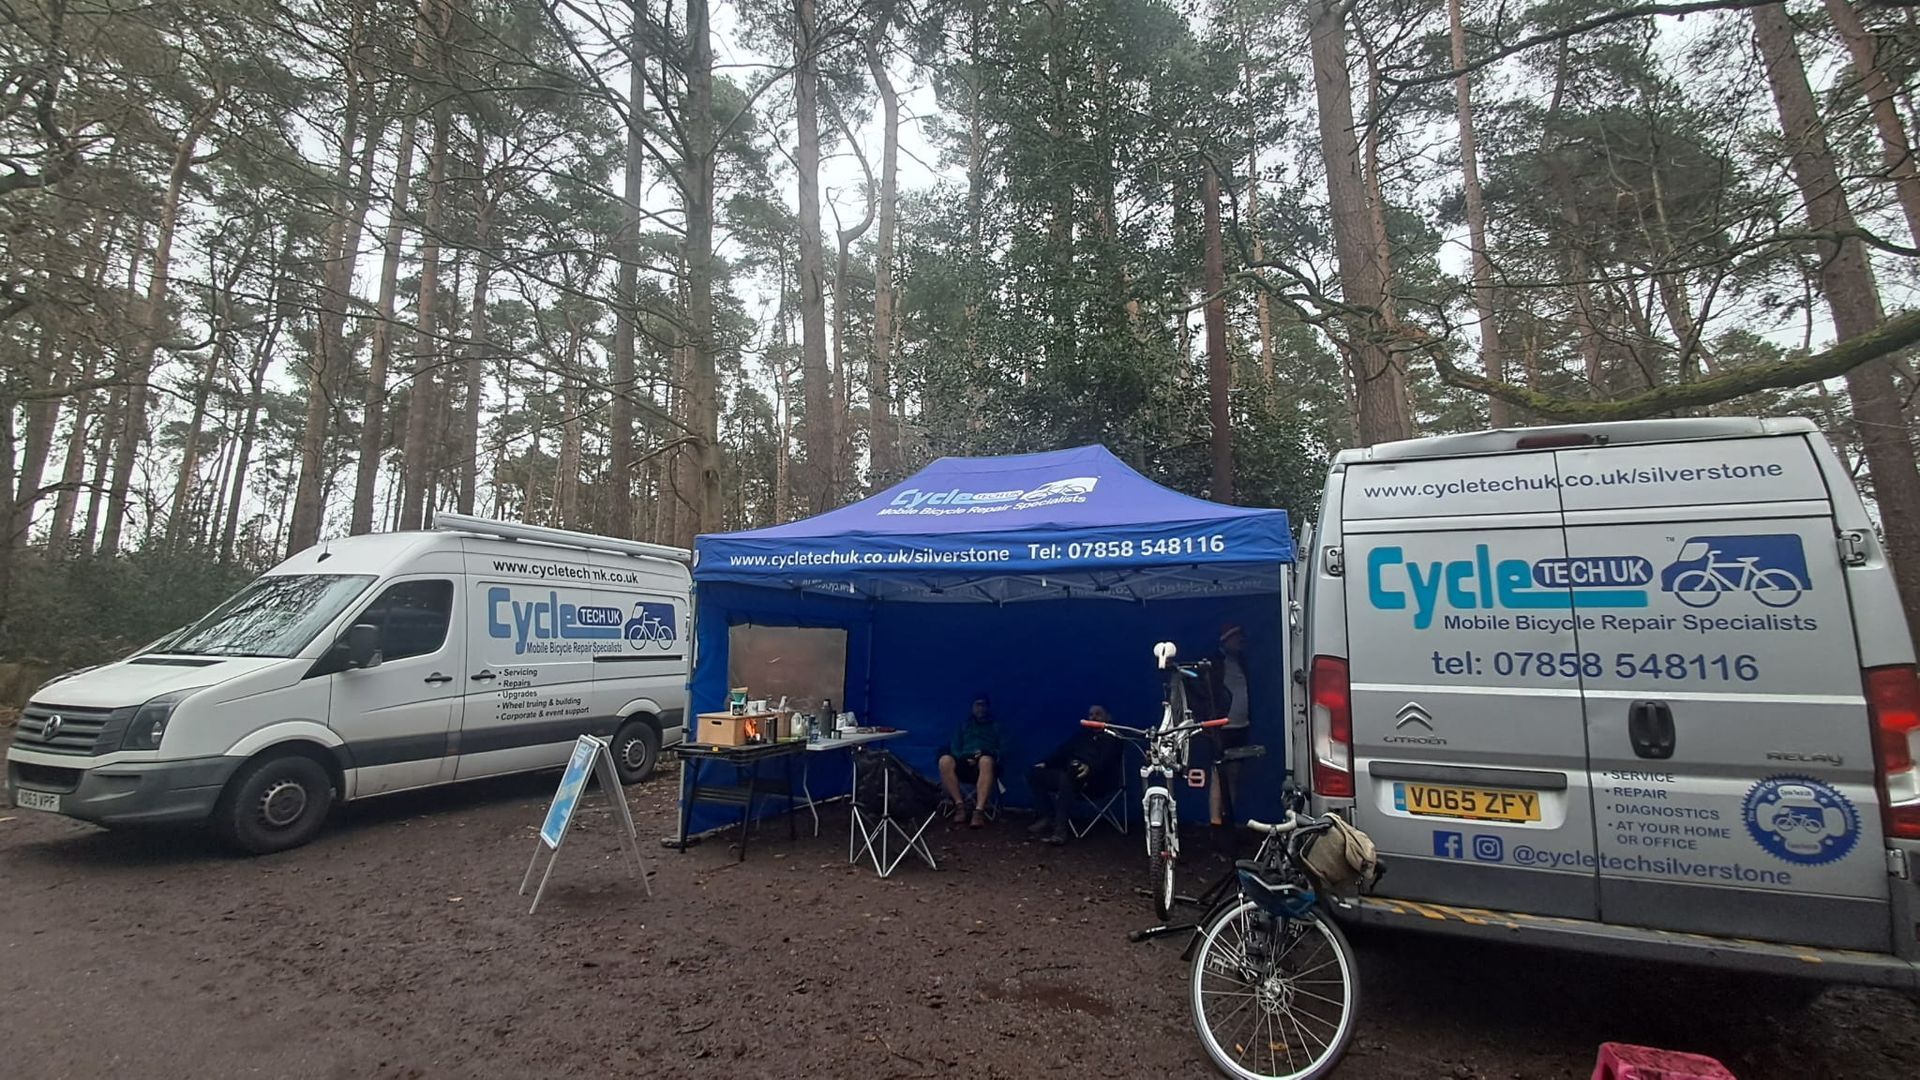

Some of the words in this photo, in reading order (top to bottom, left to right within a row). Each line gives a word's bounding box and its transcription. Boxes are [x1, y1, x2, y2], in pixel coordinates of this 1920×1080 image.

[1364, 461, 1782, 499] www.cycletechuk.co.uk/silverstone
[877, 507, 919, 517] Mobile
[919, 507, 966, 517] Bicycle
[966, 504, 1009, 515] Repair
[1012, 495, 1086, 510] Specialists
[890, 489, 977, 508] Cycle
[730, 548, 1010, 569] www.cycletechuk.co.uk/silverstone
[1027, 544, 1061, 560] Tel:
[1068, 540, 1133, 559] 07858
[1140, 534, 1224, 556] 548116
[1367, 543, 1533, 630] Cycle
[1538, 561, 1606, 584] TECH
[1611, 559, 1648, 583] UK
[488, 586, 577, 655] Cycle
[580, 608, 605, 624] TECH
[607, 609, 621, 624] UK
[1444, 615, 1509, 631] Mobile
[1516, 615, 1595, 634] Bicycle
[1602, 614, 1676, 634] Repair
[1683, 614, 1818, 634] Specialists
[527, 642, 548, 654] Mobile
[549, 642, 572, 656] Bicycle
[573, 642, 592, 655] Repair
[593, 642, 622, 653] Specialists
[504, 668, 538, 677] Servicing
[1432, 651, 1482, 676] tel:
[1494, 651, 1603, 678] 07858
[1615, 653, 1759, 681] 548116
[503, 680, 531, 688] Repairs
[502, 690, 537, 699] Upgrades
[502, 701, 525, 709] Wheel
[527, 700, 547, 708] truing
[556, 698, 581, 706] building
[501, 711, 537, 720] Corporate
[545, 709, 563, 717] event
[564, 706, 589, 716] support
[1611, 770, 1675, 783] SERVICE
[1613, 787, 1667, 799] REPAIR
[1483, 792, 1534, 816] ZFY
[1615, 803, 1719, 820] DIAGNOSTICS
[1616, 821, 1633, 831] AT
[1638, 823, 1680, 835] YOUR
[1684, 826, 1731, 839] HOME
[1616, 834, 1638, 845] OR
[1643, 836, 1697, 850] OFFICE
[1513, 845, 1792, 886] @cycletechsilverstone
